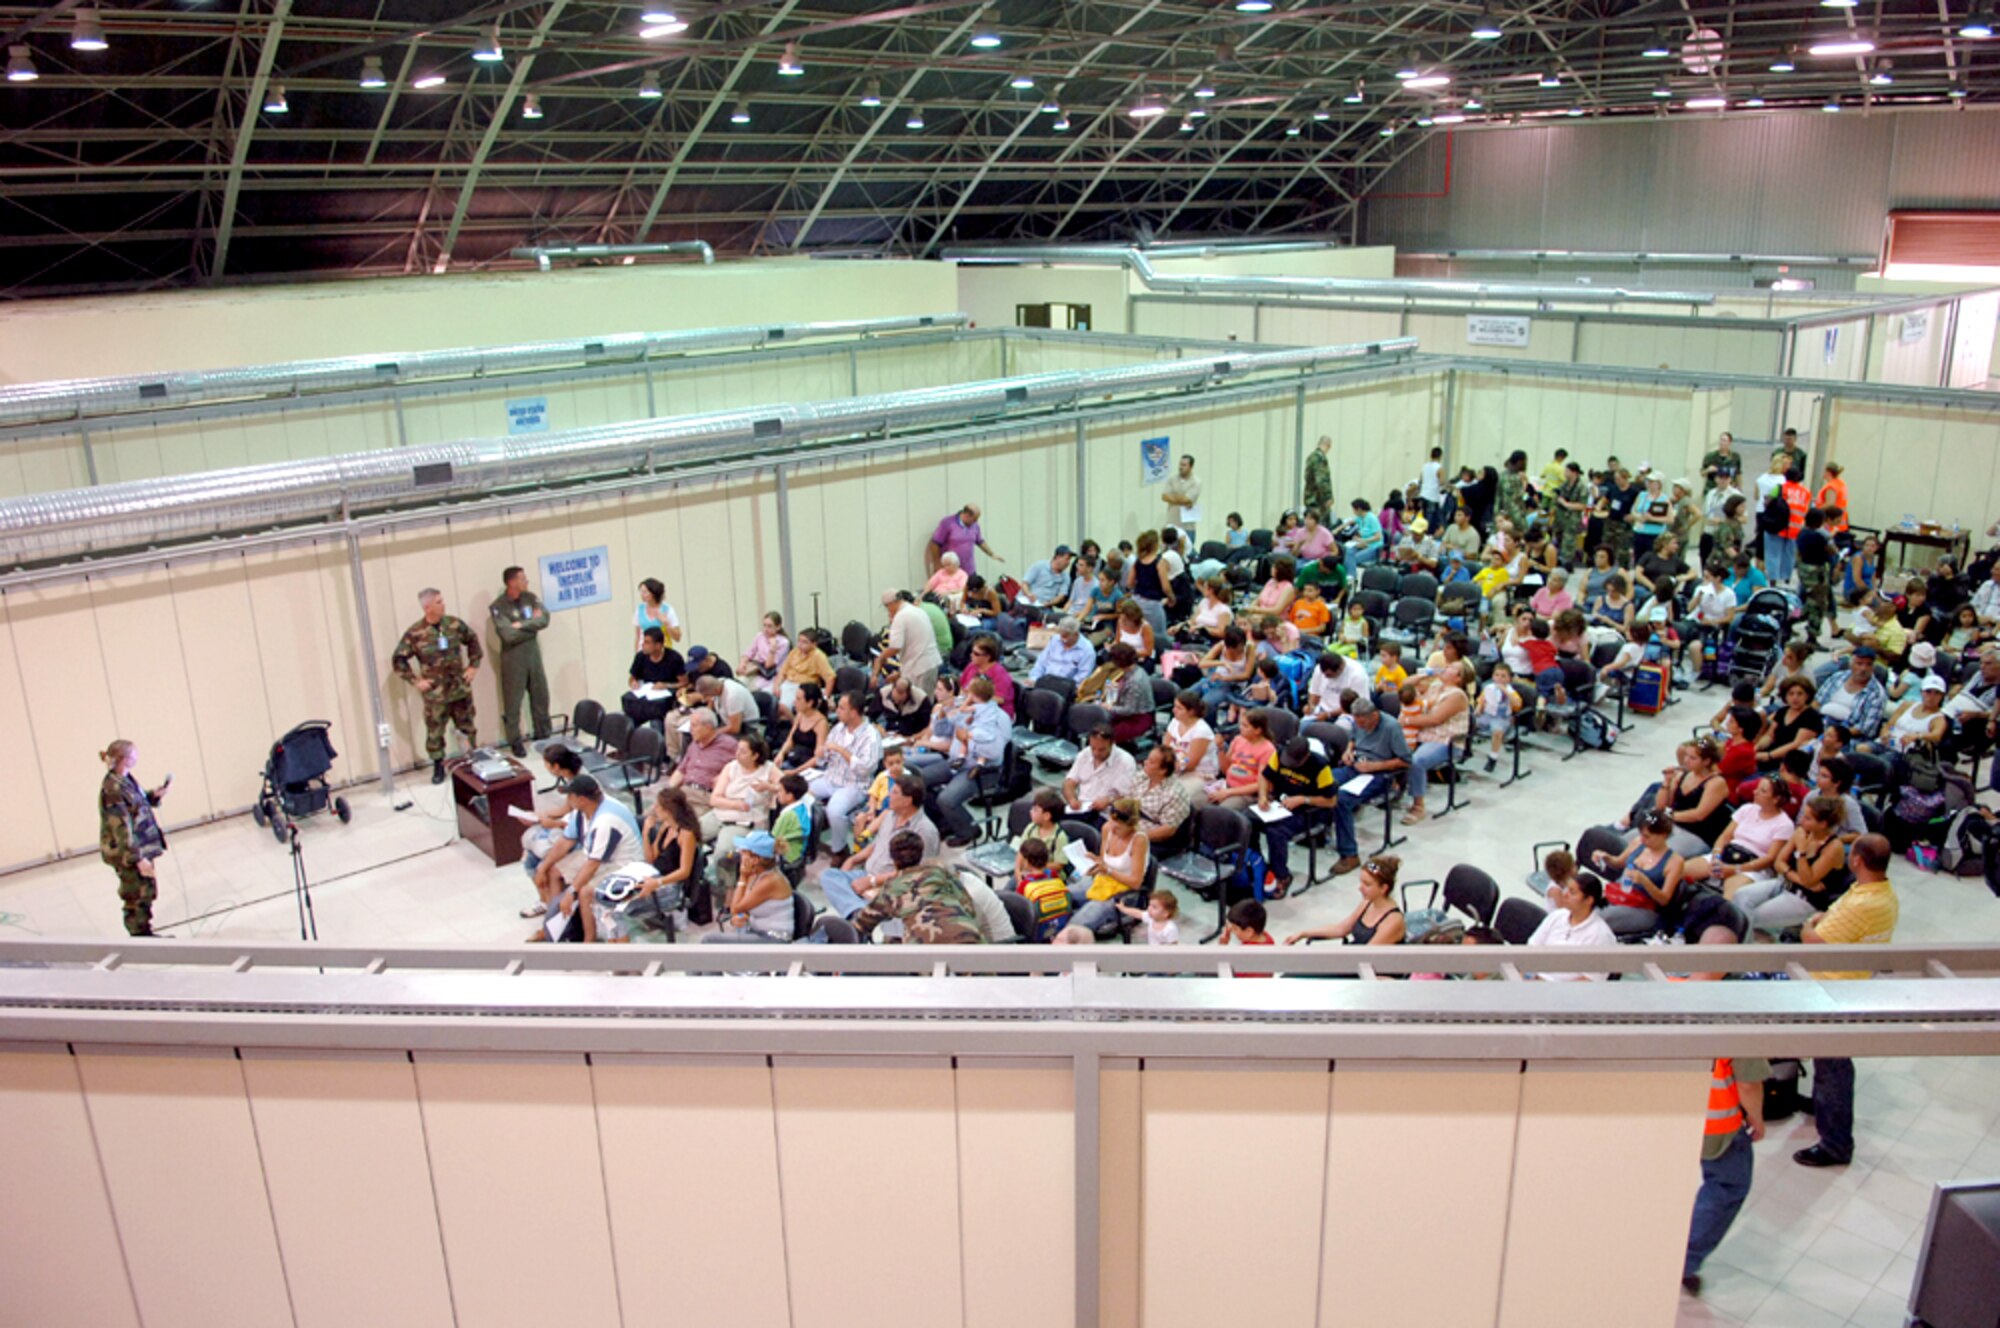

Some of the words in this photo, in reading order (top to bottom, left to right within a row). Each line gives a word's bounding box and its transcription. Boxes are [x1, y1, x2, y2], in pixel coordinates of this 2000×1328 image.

[549, 557, 588, 574] WELCOME
[589, 555, 600, 568] TO
[559, 588, 572, 601] AIR
